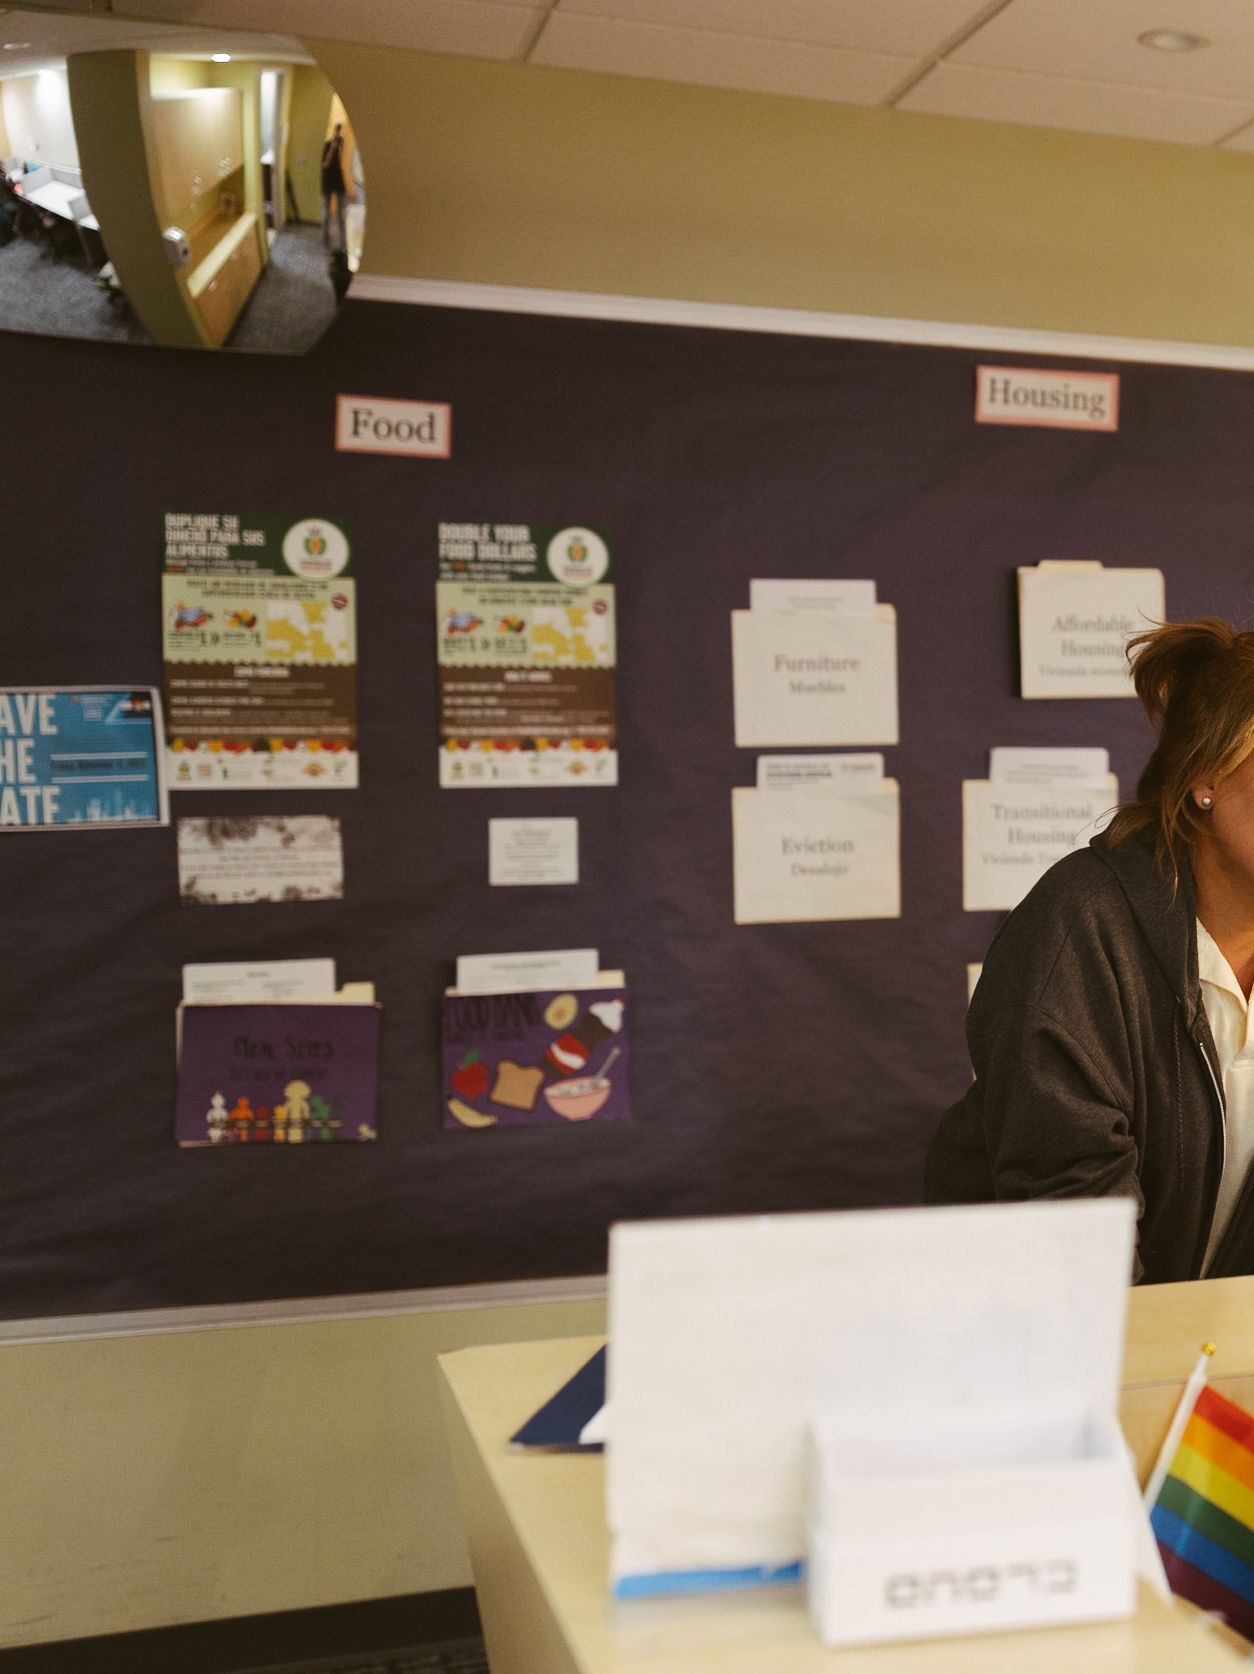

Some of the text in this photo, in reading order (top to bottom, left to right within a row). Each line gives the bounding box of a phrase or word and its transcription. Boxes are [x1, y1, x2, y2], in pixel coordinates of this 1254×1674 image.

[988, 376, 1106, 420] Housing
[351, 407, 436, 444] Food
[438, 522, 490, 542] DOUBLE
[438, 542, 538, 564] FOOD DOLLARS
[1053, 614, 1134, 633] Affordable
[1061, 640, 1126, 660] Housing
[773, 655, 862, 672] Furniture
[0, 694, 58, 735] AVE
[0, 738, 36, 784] HE
[0, 785, 61, 826] ATE
[990, 804, 1093, 821] Transitional
[781, 838, 856, 855] Eviction
[1008, 830, 1076, 847] Housing
